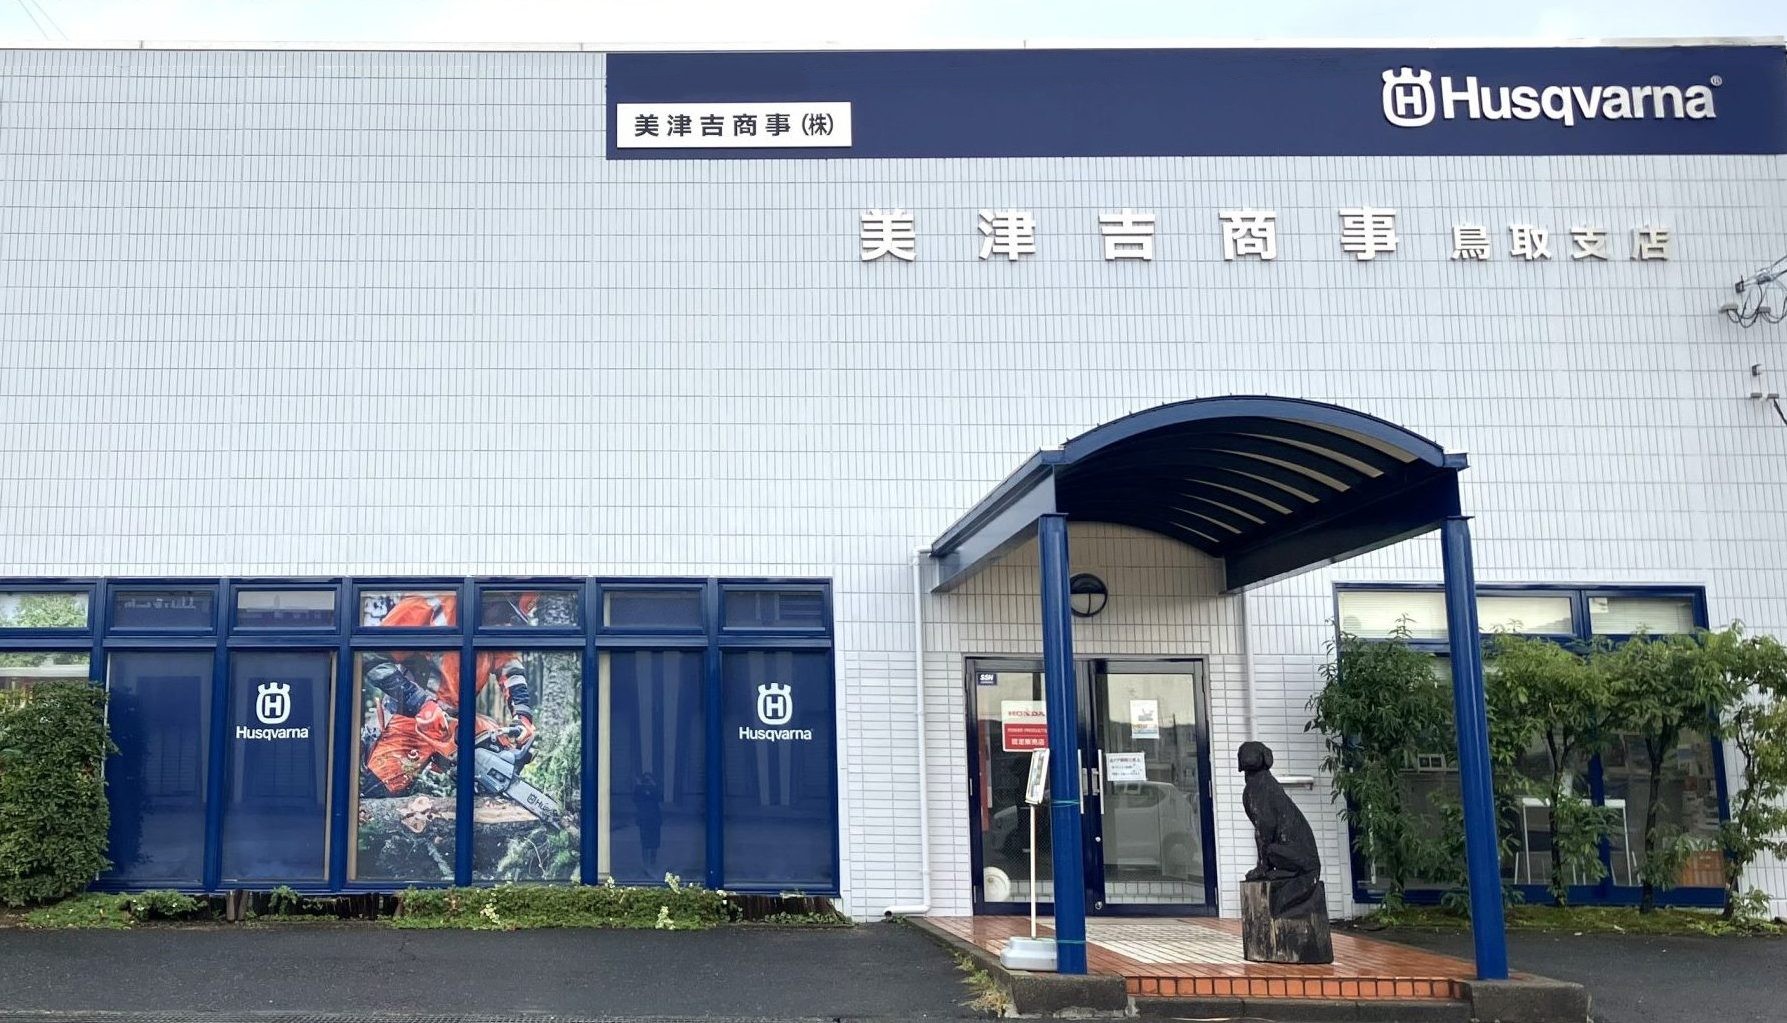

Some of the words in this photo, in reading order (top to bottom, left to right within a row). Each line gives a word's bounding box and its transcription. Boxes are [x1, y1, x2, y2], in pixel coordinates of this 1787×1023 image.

[860, 207, 1400, 262] 美津吉商事
[1450, 223, 1670, 261] 鳥取支店
